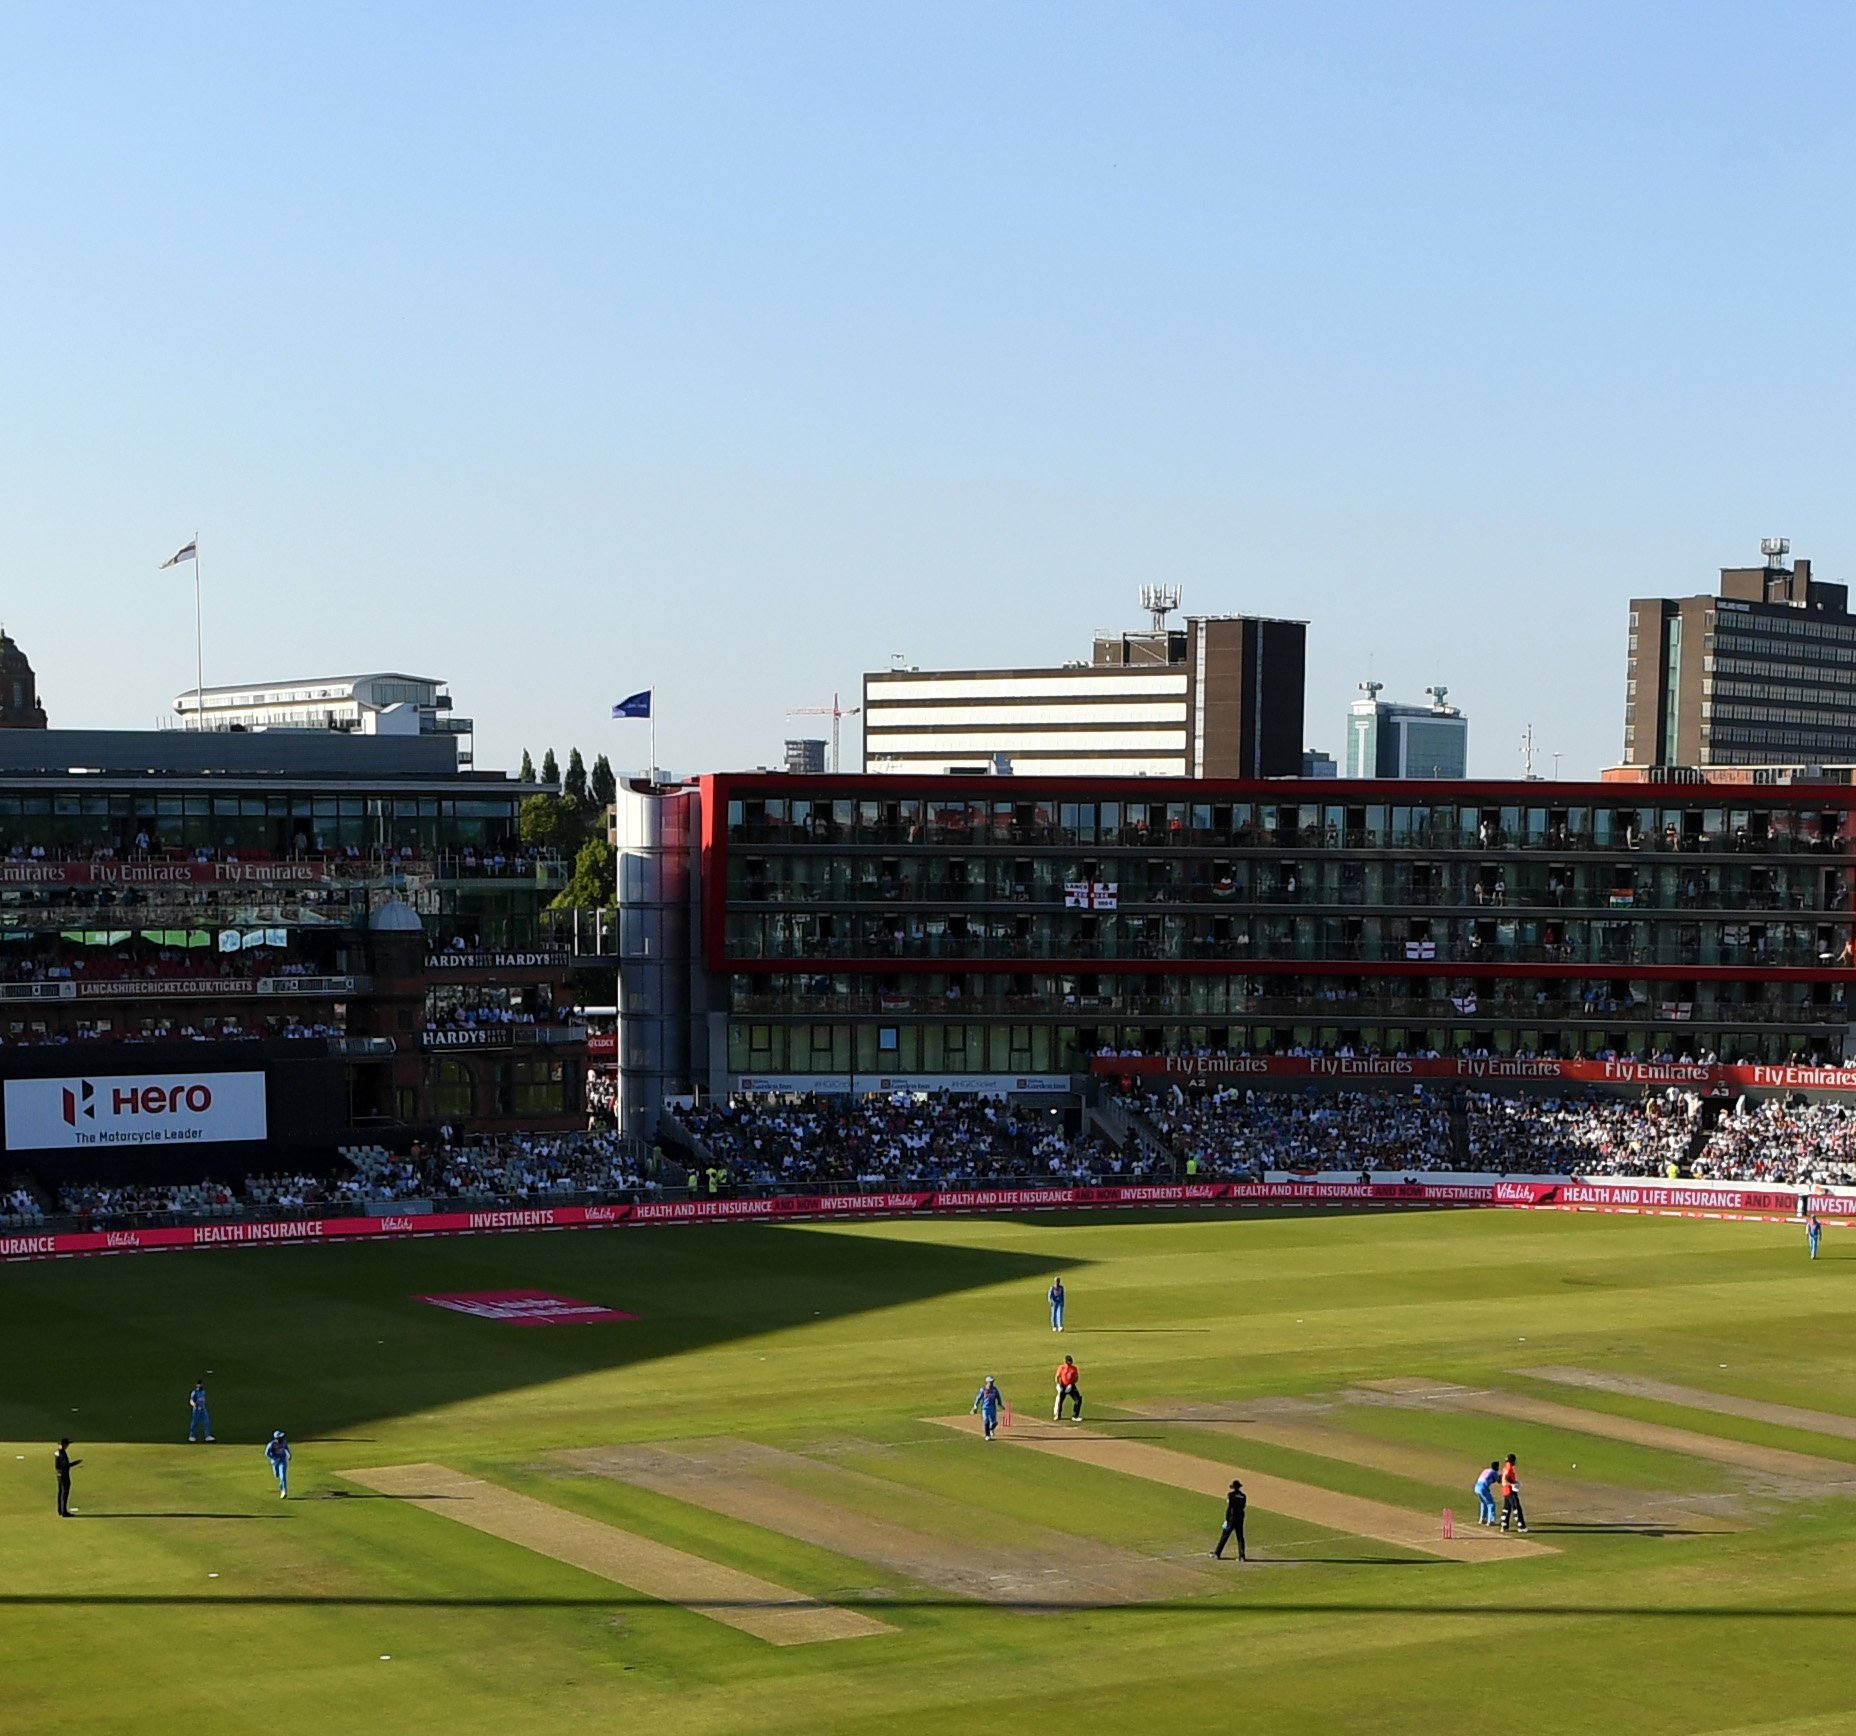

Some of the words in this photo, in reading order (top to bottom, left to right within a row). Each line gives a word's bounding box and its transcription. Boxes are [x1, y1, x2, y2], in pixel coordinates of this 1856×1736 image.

[90, 864, 116, 883] Fly
[118, 864, 192, 880] Emirates
[214, 863, 239, 882] Fly
[242, 863, 313, 880] Emirates
[82, 980, 252, 995] LANCASHIRECRICKET.CO.UK/TICKETS
[1166, 1057, 1200, 1074] Fly
[1204, 1057, 1268, 1073] Emirates
[1310, 1058, 1345, 1076] Fly
[1347, 1058, 1413, 1074] Emirates
[1457, 1061, 1487, 1077] Fly
[1489, 1061, 1561, 1075] Emirates
[1605, 1063, 1635, 1080] Fly
[1638, 1063, 1709, 1079] Emirates
[1188, 1079, 1206, 1087] A2
[1755, 1066, 1783, 1085] Fly
[1711, 1088, 1729, 1097] A3
[76, 1133, 95, 1144] The
[99, 1130, 161, 1144] Motorcycle
[164, 1129, 203, 1139] Leader
[939, 1194, 973, 1205] HEALTH
[975, 1193, 997, 1204] AND
[1000, 1193, 1017, 1203] LIFE
[1020, 1190, 1072, 1202] INSURANCE
[1121, 1187, 1182, 1199] INVESTMENTS
[1186, 1184, 1213, 1198] Vitality
[1233, 1186, 1268, 1197] HEALTH
[1271, 1186, 1292, 1197] AND
[1295, 1186, 1314, 1196] LIFE
[1317, 1186, 1373, 1197] INSURANCE
[1425, 1187, 1492, 1199] INVESTMENTS
[1496, 1183, 1535, 1202] Vitality
[1564, 1186, 1608, 1203] HEALTH
[1612, 1189, 1639, 1204] AND
[1642, 1190, 1668, 1205] LIFE
[1670, 1192, 1741, 1207] INSURANCE
[638, 1205, 672, 1218] HEALTH
[675, 1204, 695, 1216] AND
[698, 1204, 717, 1215] LIFE
[719, 1201, 772, 1214] INSURANCE
[822, 1196, 884, 1210] INVESTMENTS
[887, 1194, 917, 1208] Vitality
[469, 1210, 553, 1227] INVESTMENTS
[585, 1207, 614, 1221] Vitality
[194, 1225, 244, 1242] HEALTH
[248, 1221, 322, 1239] INSURANCE
[381, 1216, 413, 1232] Vitality
[107, 1232, 140, 1247] Vitality
